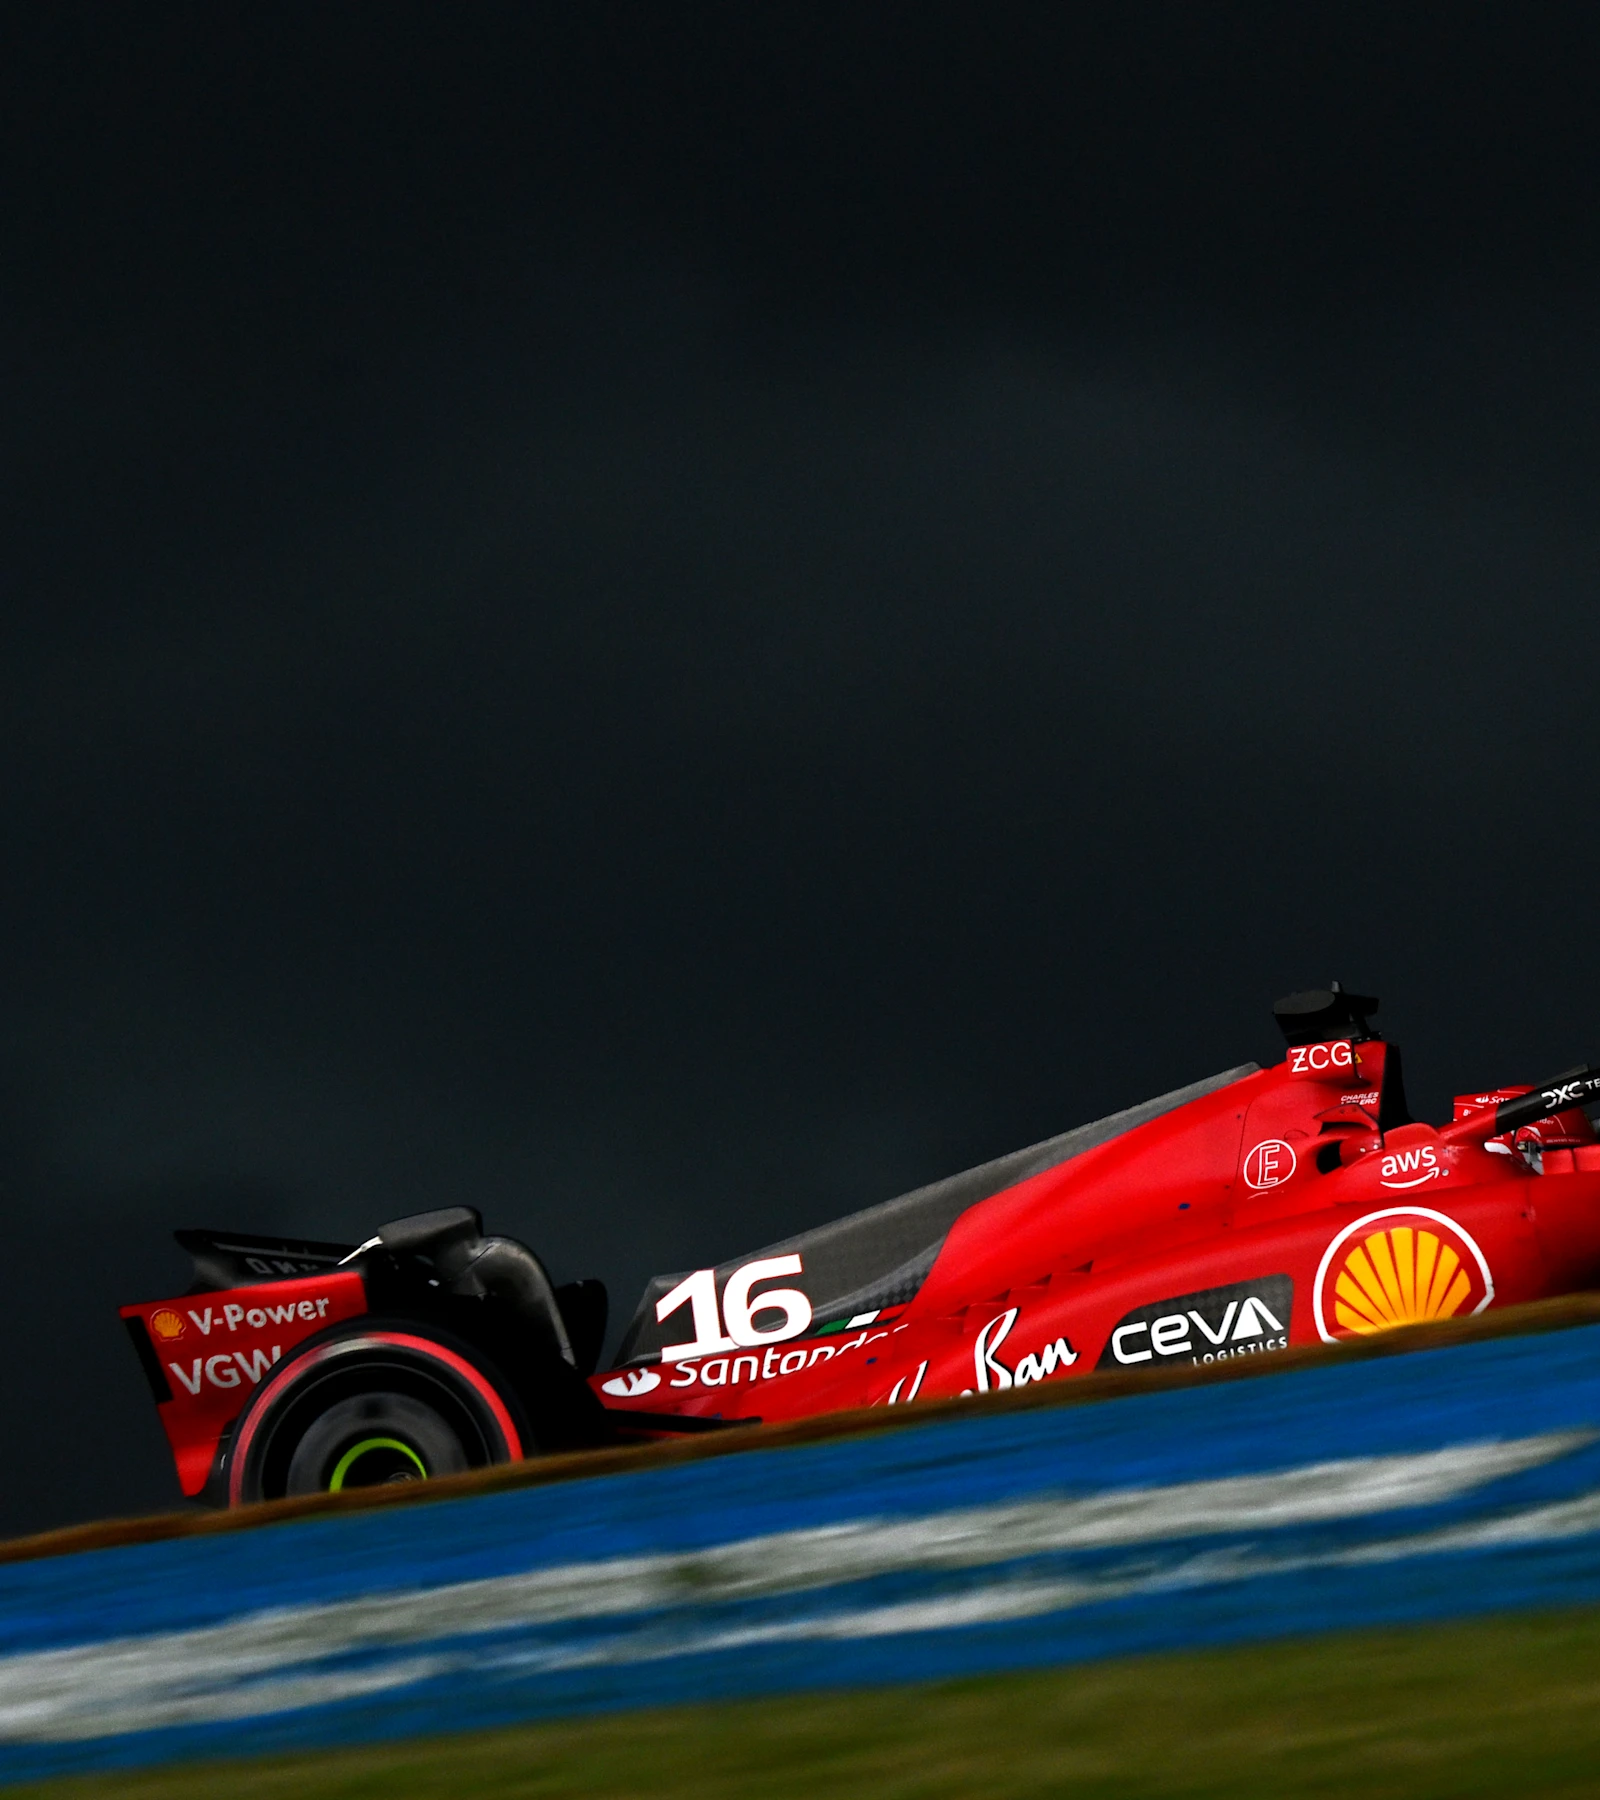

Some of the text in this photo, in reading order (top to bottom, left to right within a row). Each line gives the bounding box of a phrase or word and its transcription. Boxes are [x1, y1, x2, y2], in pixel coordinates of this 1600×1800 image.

[1339, 1092, 1380, 1102] CHARLES
[1380, 1145, 1437, 1178] aws
[187, 1297, 330, 1336] V-Power
[655, 1252, 813, 1363] 16
[1192, 1336, 1288, 1367] LOGISTICS
[168, 1344, 281, 1396] VGW
